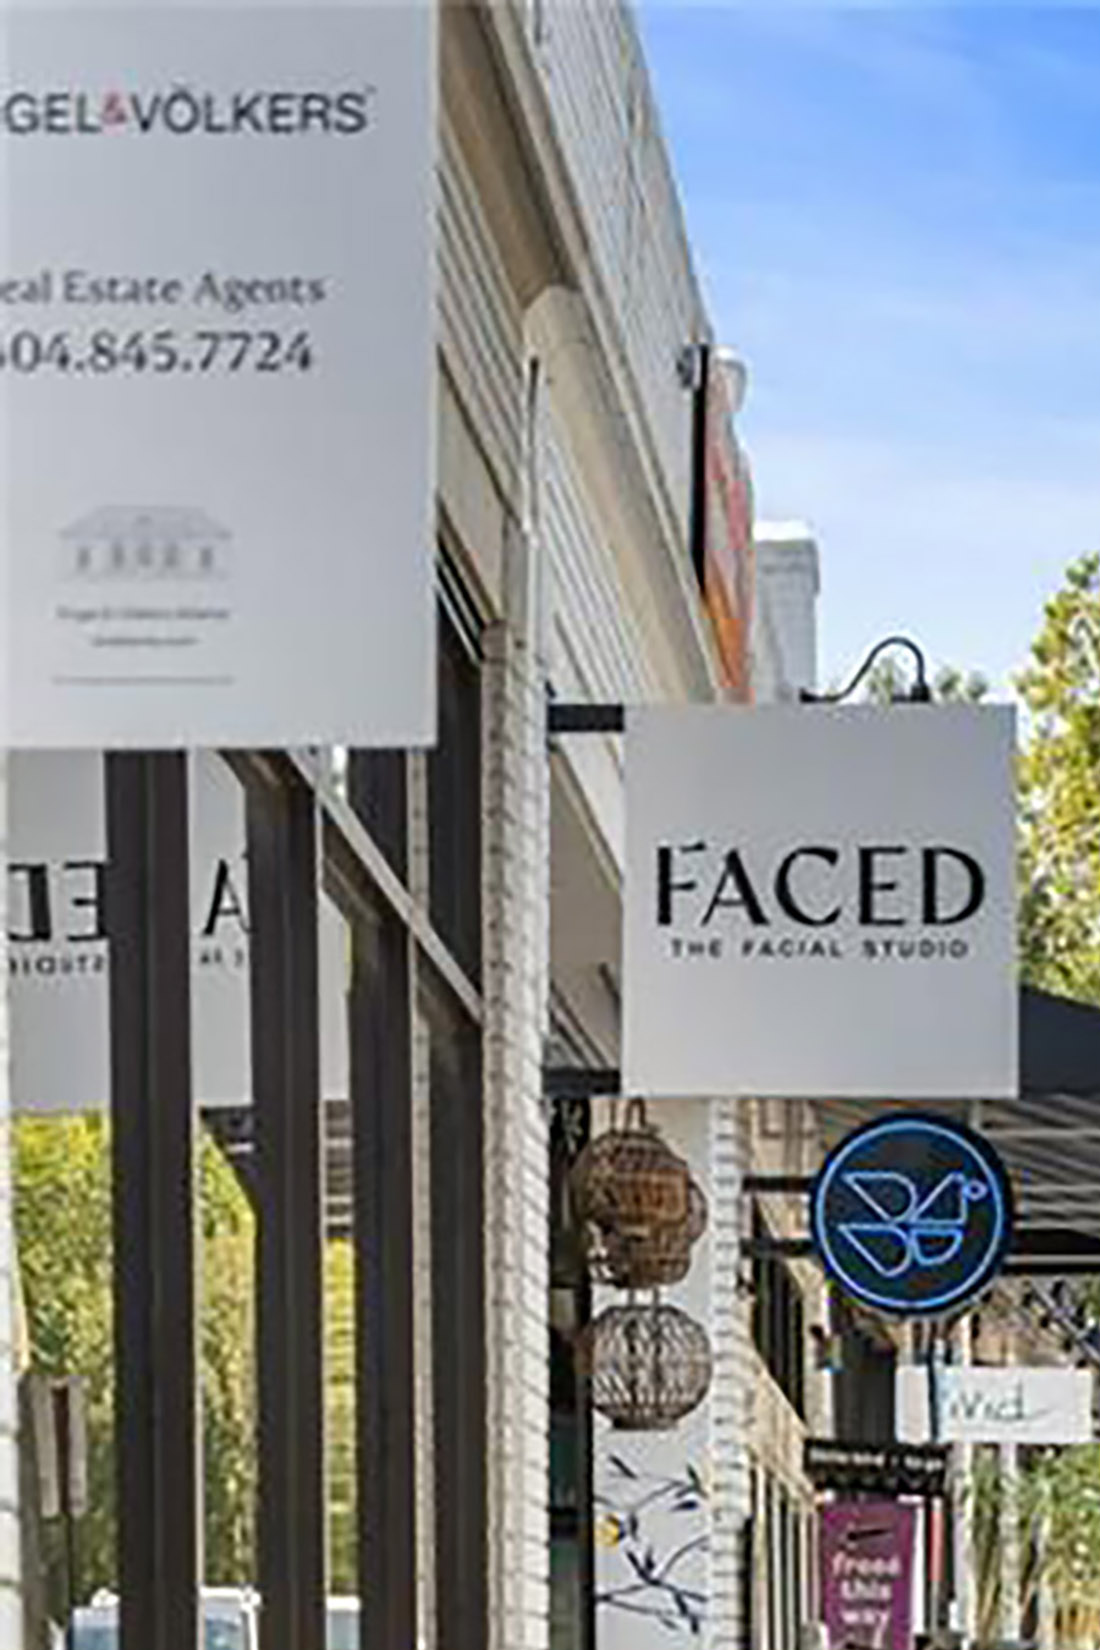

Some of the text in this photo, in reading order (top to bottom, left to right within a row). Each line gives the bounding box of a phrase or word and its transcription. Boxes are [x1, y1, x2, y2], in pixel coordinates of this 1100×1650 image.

[62, 271, 184, 304] Estate
[193, 272, 327, 313] Agents
[657, 842, 986, 926] FACED
[671, 938, 969, 959] THE FACIAL STUDIO
[840, 1609, 891, 1650] way
